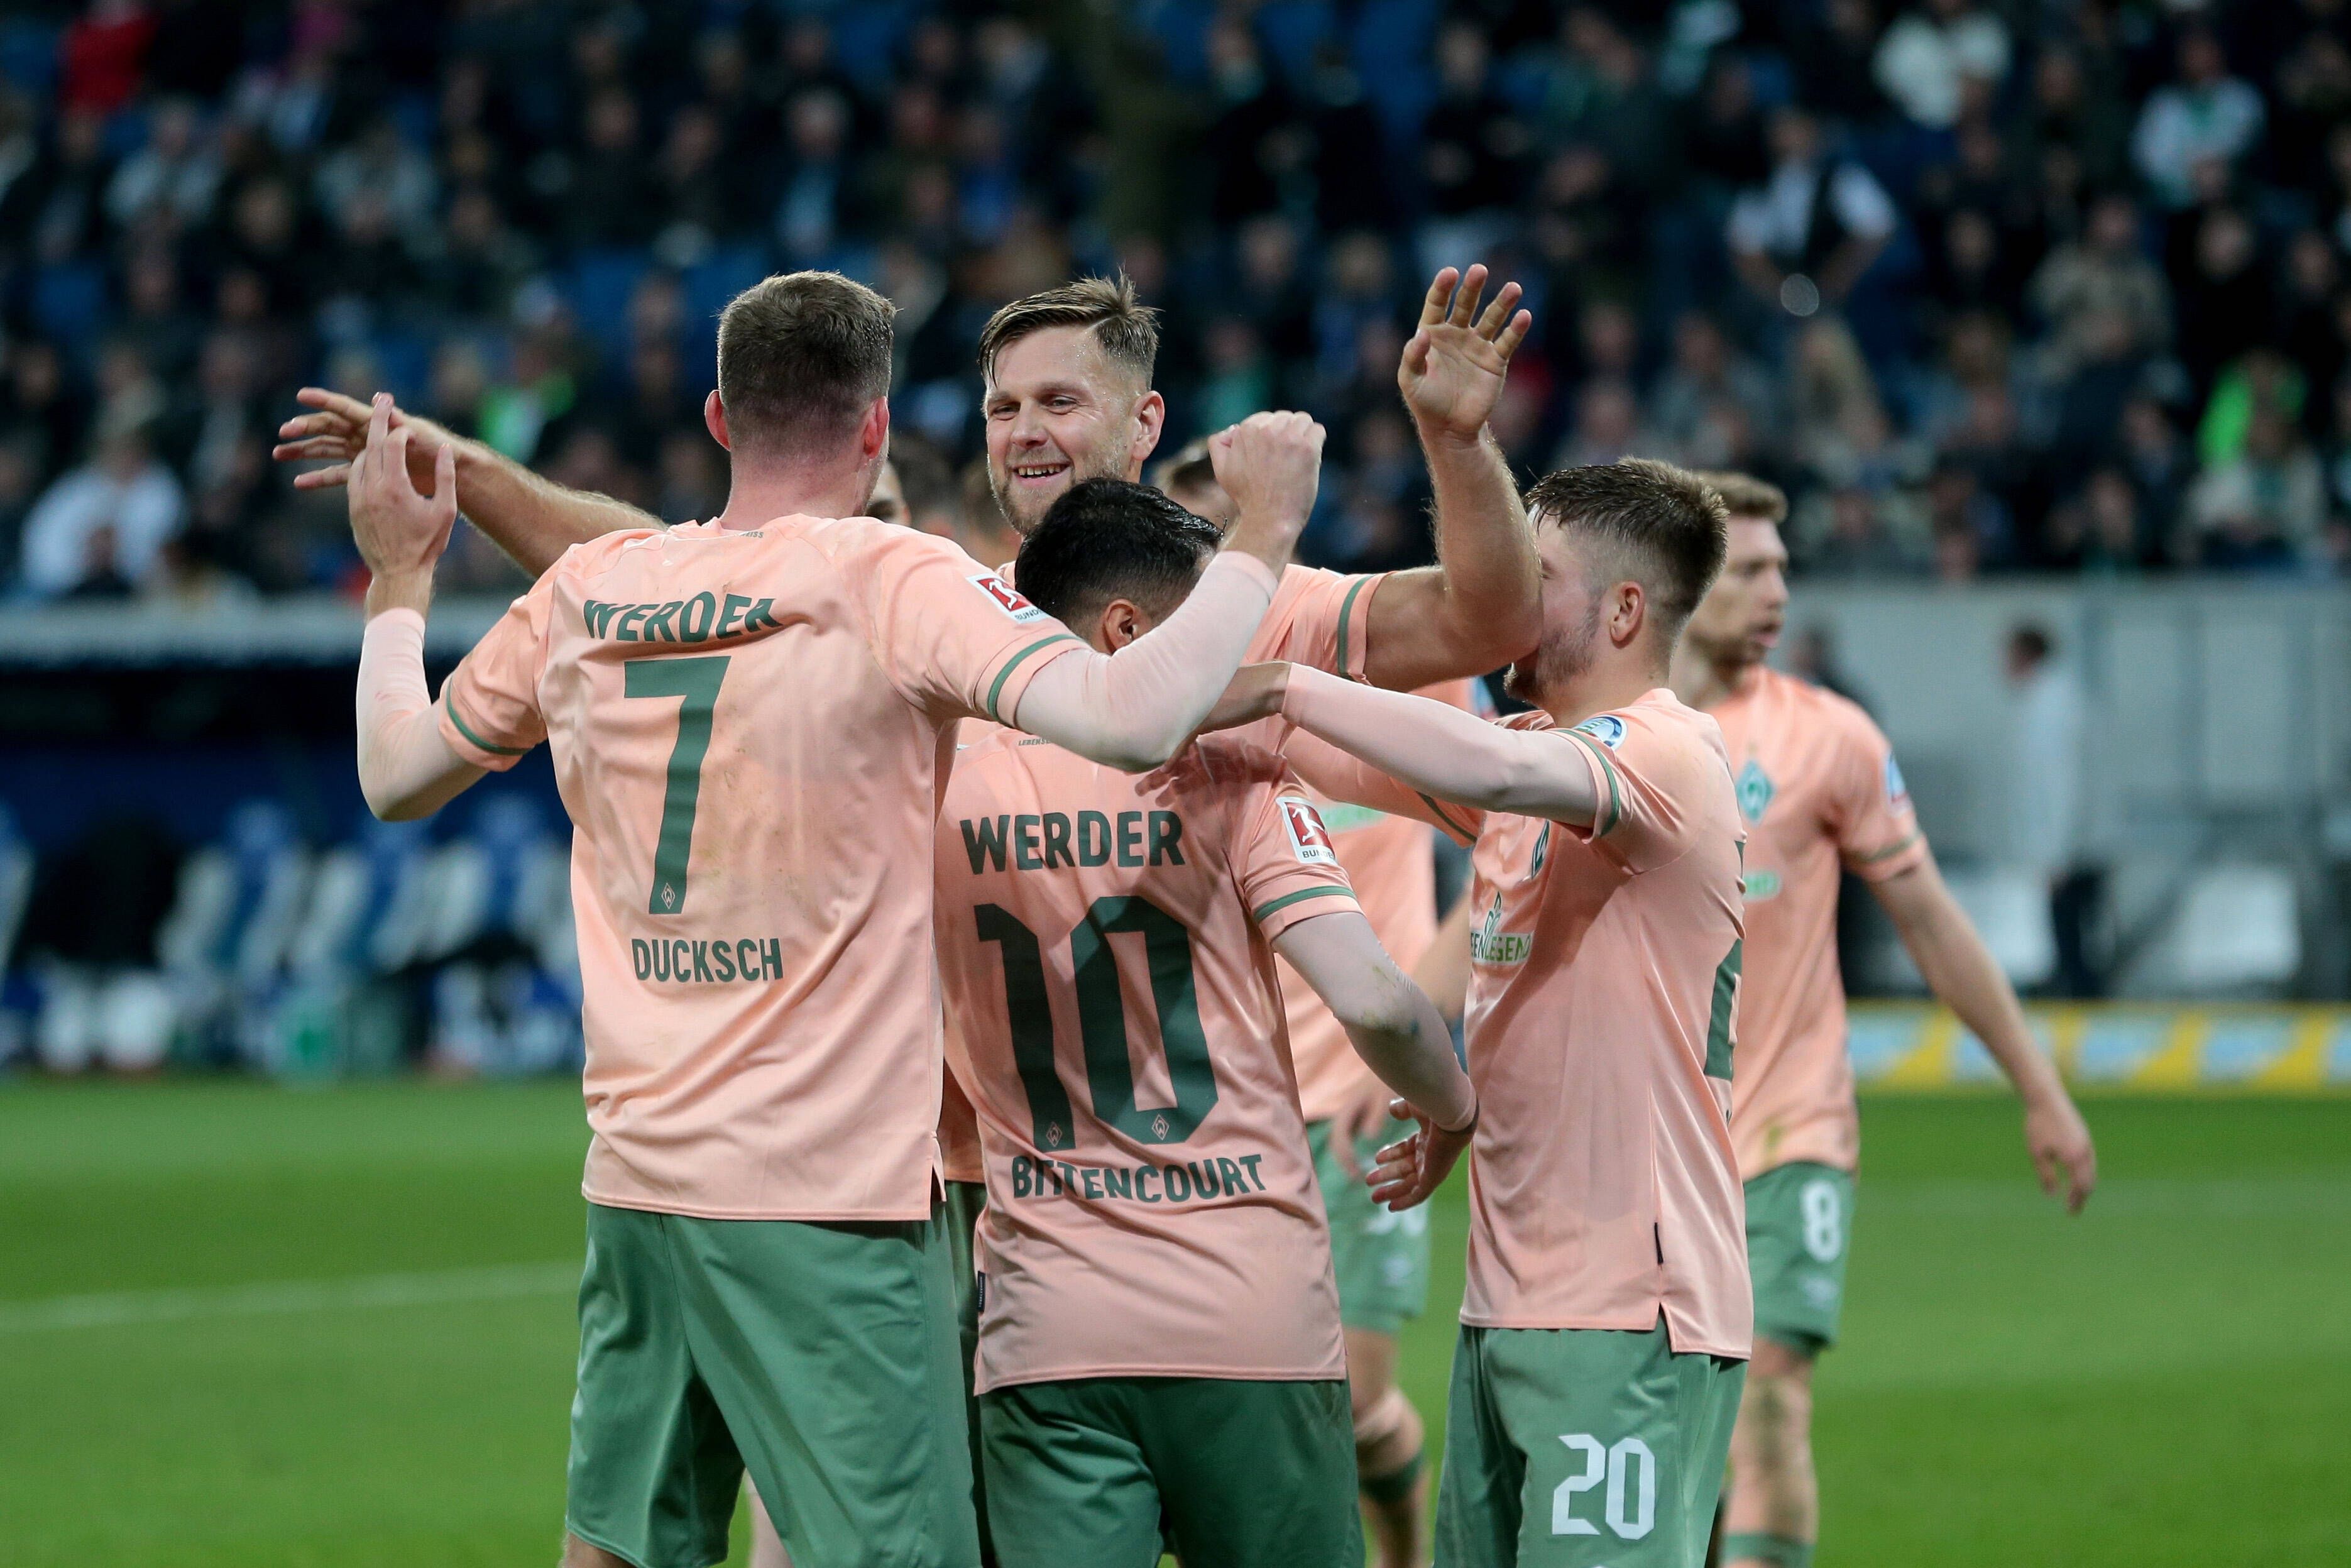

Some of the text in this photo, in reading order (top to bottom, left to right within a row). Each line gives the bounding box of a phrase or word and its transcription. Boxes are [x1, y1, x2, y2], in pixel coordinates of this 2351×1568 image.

[583, 591, 783, 642] WERDER
[623, 655, 732, 915] 7
[960, 811, 1185, 875] WERDER
[632, 938, 784, 982] DUCKSCH
[974, 896, 1219, 1151] 10
[1012, 1154, 1267, 1203] BITTENCOURT
[1800, 1180, 1842, 1263] 8
[1552, 1434, 1656, 1540] 20
